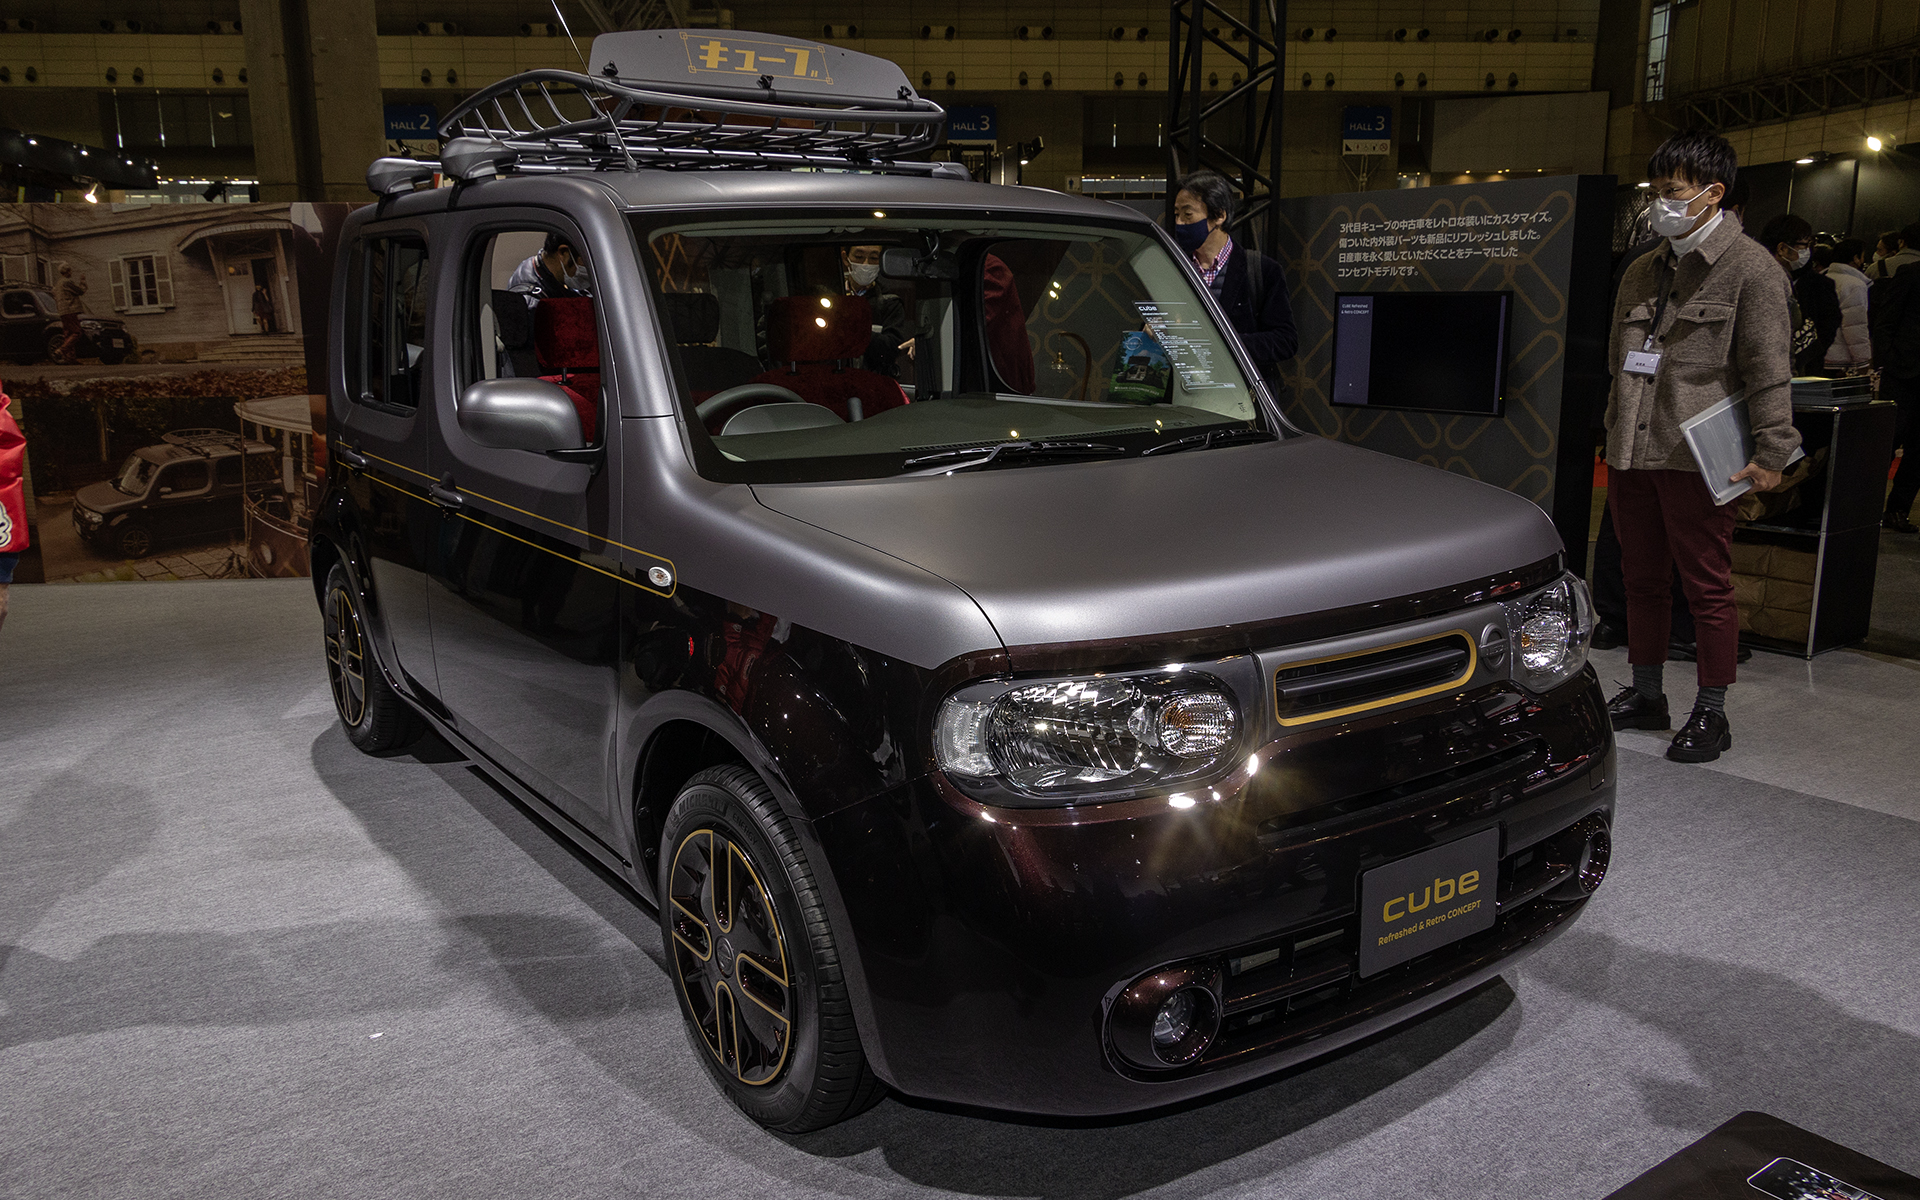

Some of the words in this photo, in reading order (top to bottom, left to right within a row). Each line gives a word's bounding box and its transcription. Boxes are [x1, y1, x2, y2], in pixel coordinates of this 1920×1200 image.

[699, 40, 819, 77] キューブ
[391, 122, 416, 130] HALL
[419, 114, 431, 130] 2
[953, 123, 978, 131] HALL
[980, 115, 990, 131] 3
[1349, 123, 1373, 131] HALL
[1375, 116, 1385, 131] 3
[1340, 211, 1553, 233] 3代目キューブの中古車をレトロな装いにカスタマイズ。
[1339, 228, 1541, 248] 傷ついた内外装パーツも新品にリフレッシュしました。
[1338, 246, 1519, 263] 日産車を永く愛していただくことをテーマにした
[1338, 265, 1419, 277] コンセプトモデルです。
[679, 793, 726, 816] MICHELIN
[732, 813, 758, 846] ENERGY
[1383, 870, 1480, 923] cube
[1378, 923, 1418, 946] Refreshed
[1418, 920, 1425, 931] &
[1425, 913, 1447, 928] Retro
[1447, 899, 1482, 919] CONCEPT
